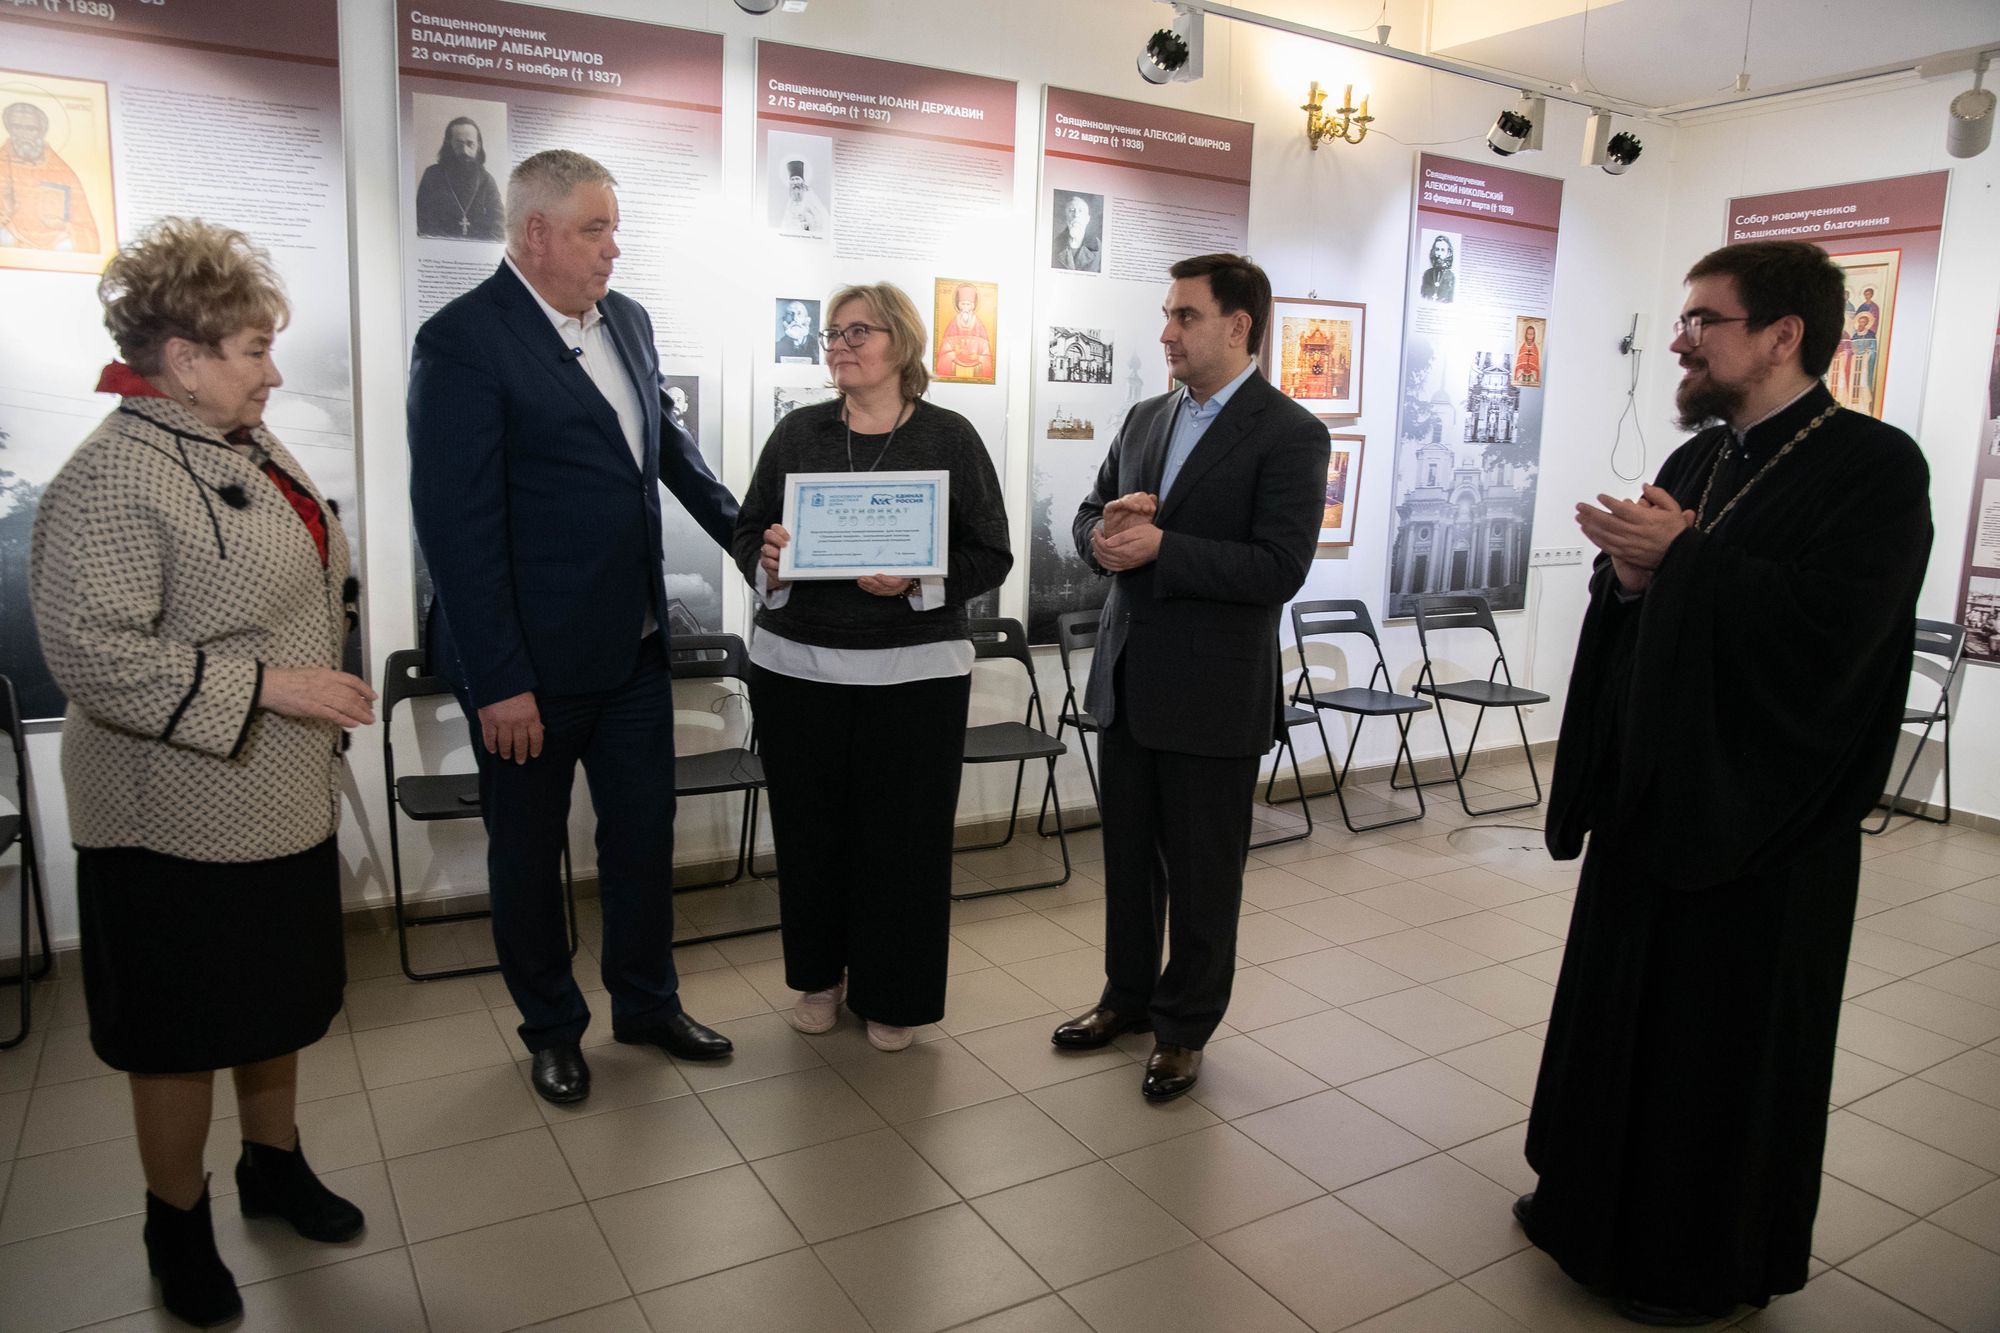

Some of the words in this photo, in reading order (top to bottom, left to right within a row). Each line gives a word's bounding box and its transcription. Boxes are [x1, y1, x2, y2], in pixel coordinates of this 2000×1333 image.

[411, 11, 547, 41] Священномученик
[411, 29, 498, 51] ВЛАДИМИР
[501, 42, 604, 66] АМБАРЦУМОВ
[412, 47, 429, 61] 23
[433, 50, 494, 71] октября
[505, 58, 513, 72] 5
[517, 61, 568, 80] ноября
[588, 69, 622, 87] 1937)
[769, 78, 877, 104] Священномученик
[879, 95, 919, 111] ИОАНН
[921, 101, 984, 121] ДЕРЖАВИН
[798, 101, 847, 117] декабря
[863, 107, 891, 123] 1937)
[1055, 127, 1061, 137] 9
[1068, 129, 1080, 140] 22
[1081, 133, 1109, 146] марта
[1122, 138, 1144, 152] 1938)
[1056, 113, 1142, 137] Священномученик
[1143, 127, 1187, 144] АЛЕКСИЙ
[1188, 136, 1231, 151] СМИРНОВ
[1426, 169, 1485, 187] Священномученик
[1424, 191, 1432, 200] 23
[1425, 181, 1457, 193] АЛЕКСИЙ
[1459, 186, 1503, 201] НИКОЛЬСКИЙ
[1734, 223, 1820, 240] Балашихинского
[1823, 215, 1890, 231] благочиния
[1735, 213, 1769, 226] Собор
[1771, 204, 1857, 222] новомучеников
